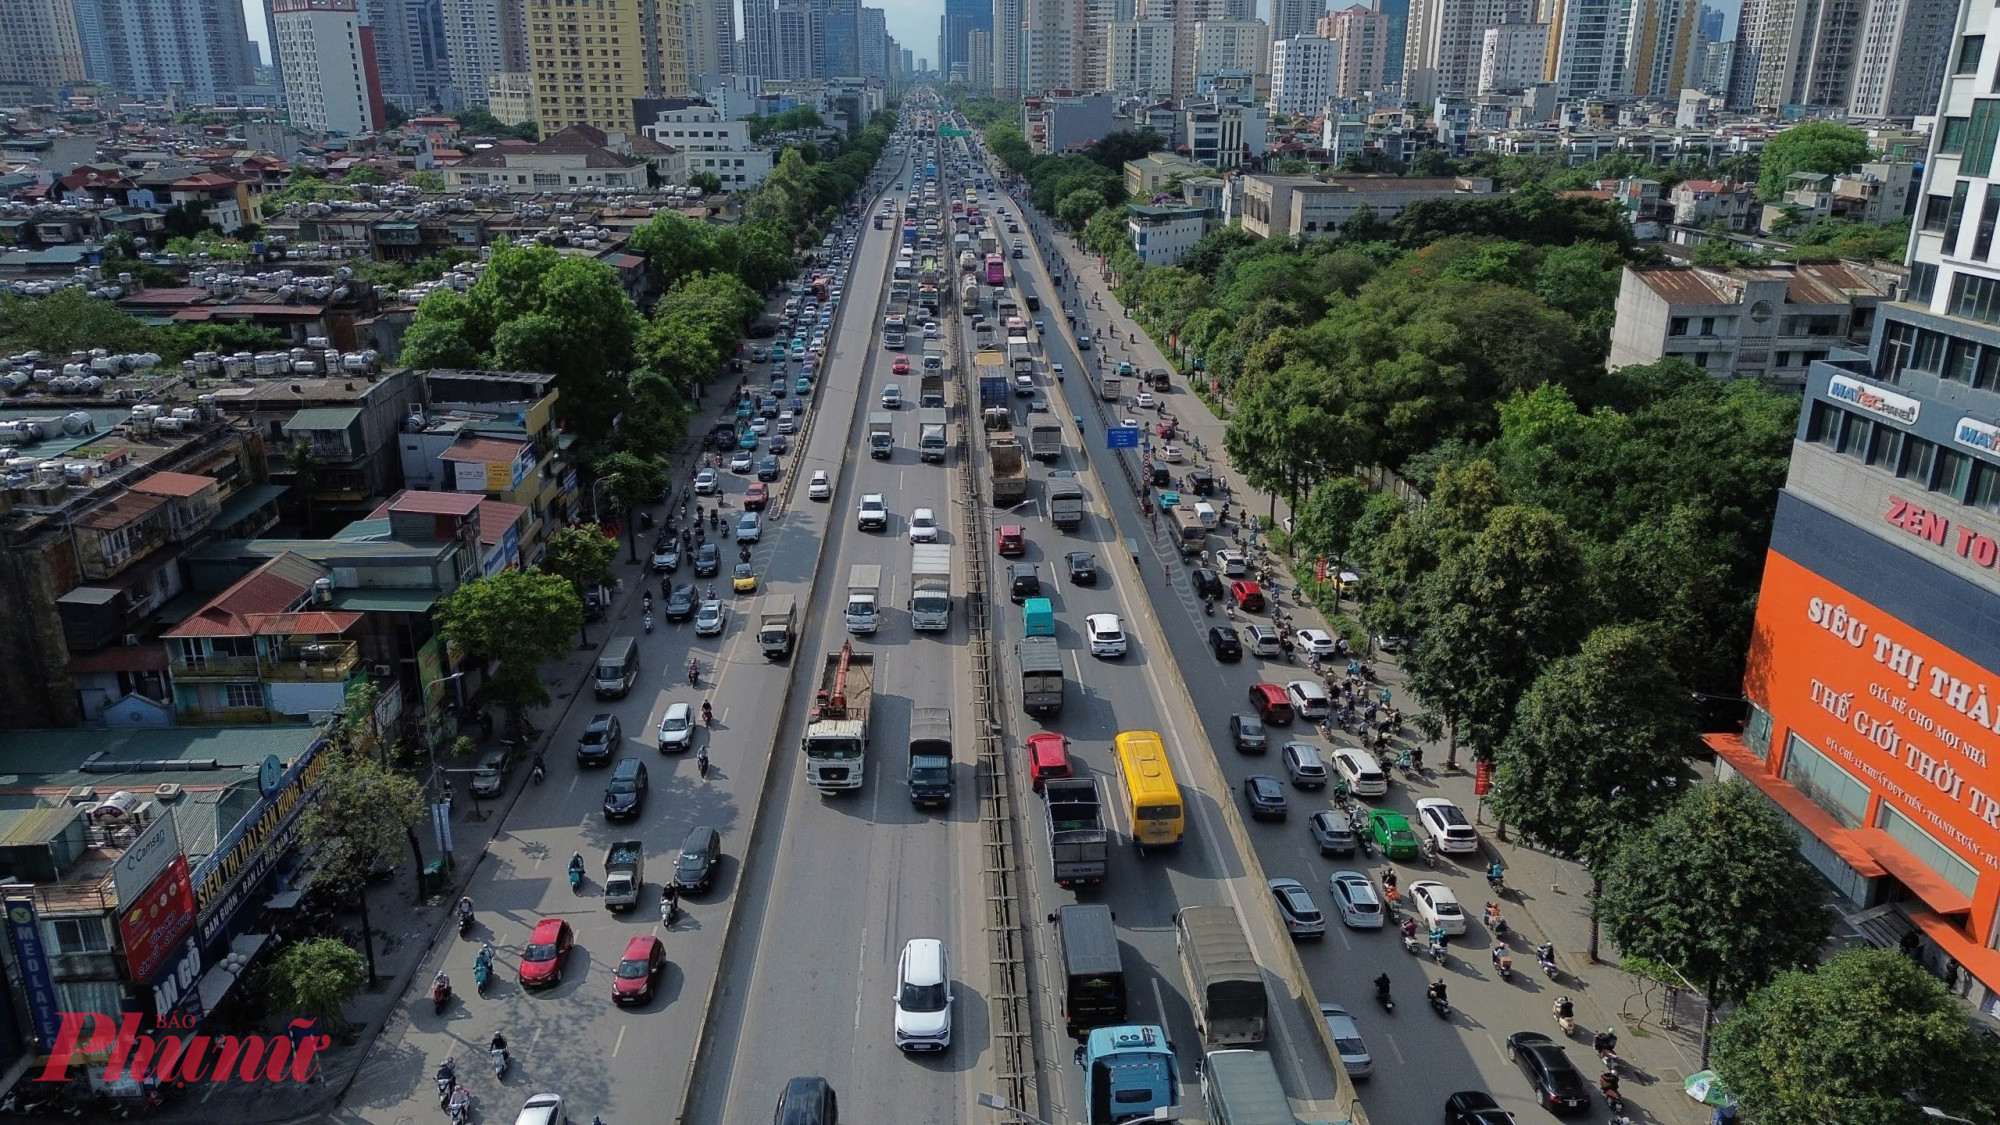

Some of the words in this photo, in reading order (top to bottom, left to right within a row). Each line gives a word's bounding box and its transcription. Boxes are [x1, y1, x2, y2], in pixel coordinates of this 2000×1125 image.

[1884, 494, 1949, 547] ZEN
[1956, 524, 2000, 575] TO
[1808, 596, 1868, 648] SIÊU
[1873, 633, 1924, 690] THỊ
[1810, 678, 1854, 723] THẾ
[1853, 710, 1902, 759] GIỚI
[1904, 743, 1965, 802] THỜI
[1968, 786, 2000, 832] TR
[1869, 682, 1891, 704] GIÁ
[1908, 708, 1934, 732] CHO
[1935, 725, 1961, 750] MỌI
[1961, 743, 1988, 769] NHÀ
[136, 829, 165, 862] Camsan
[1887, 781, 1905, 799] DUY
[1927, 810, 1956, 837] THANH
